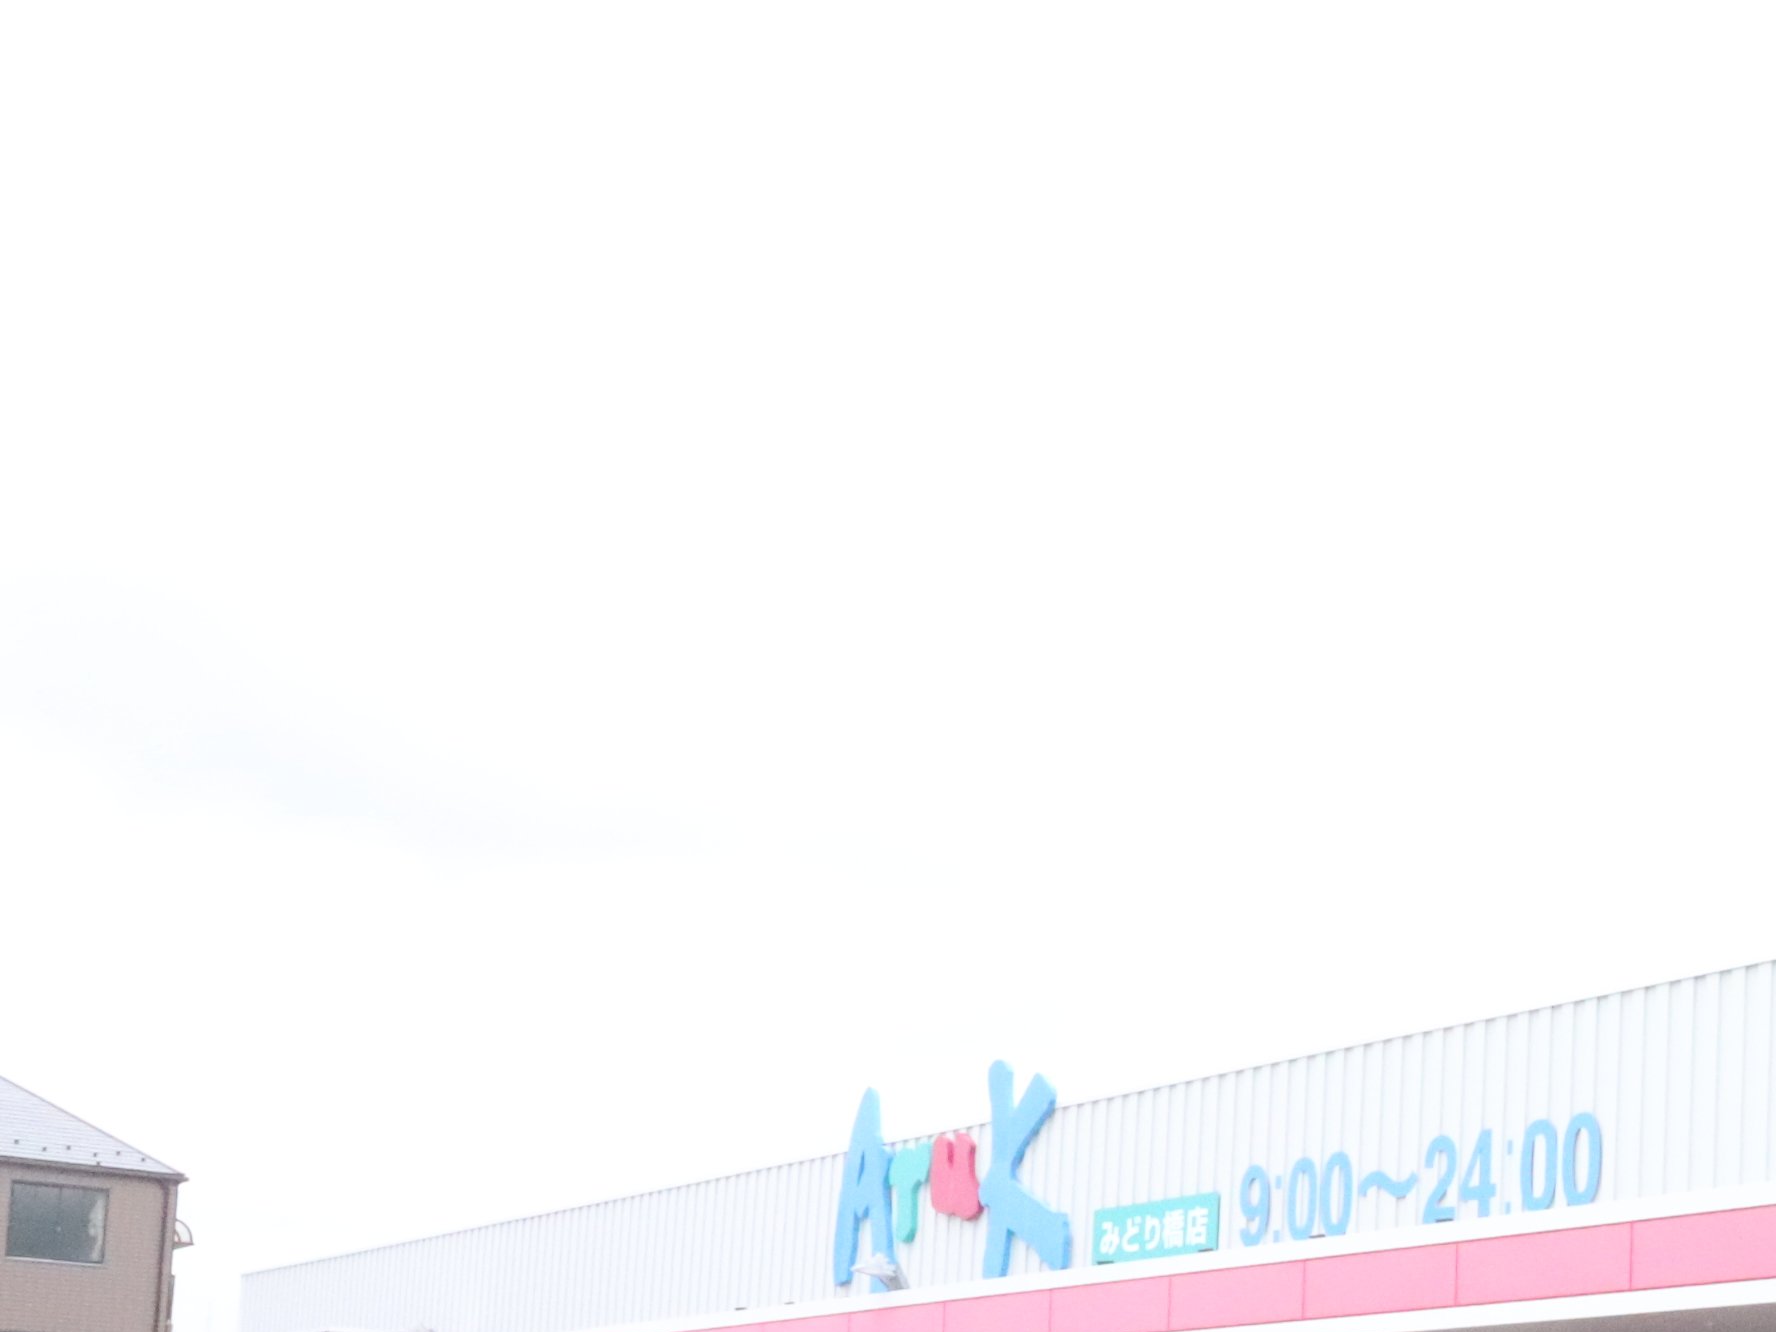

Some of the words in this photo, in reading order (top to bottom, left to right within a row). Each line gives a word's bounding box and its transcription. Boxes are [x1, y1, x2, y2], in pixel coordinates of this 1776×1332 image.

[1099, 1205, 1209, 1255] みどり橋店
